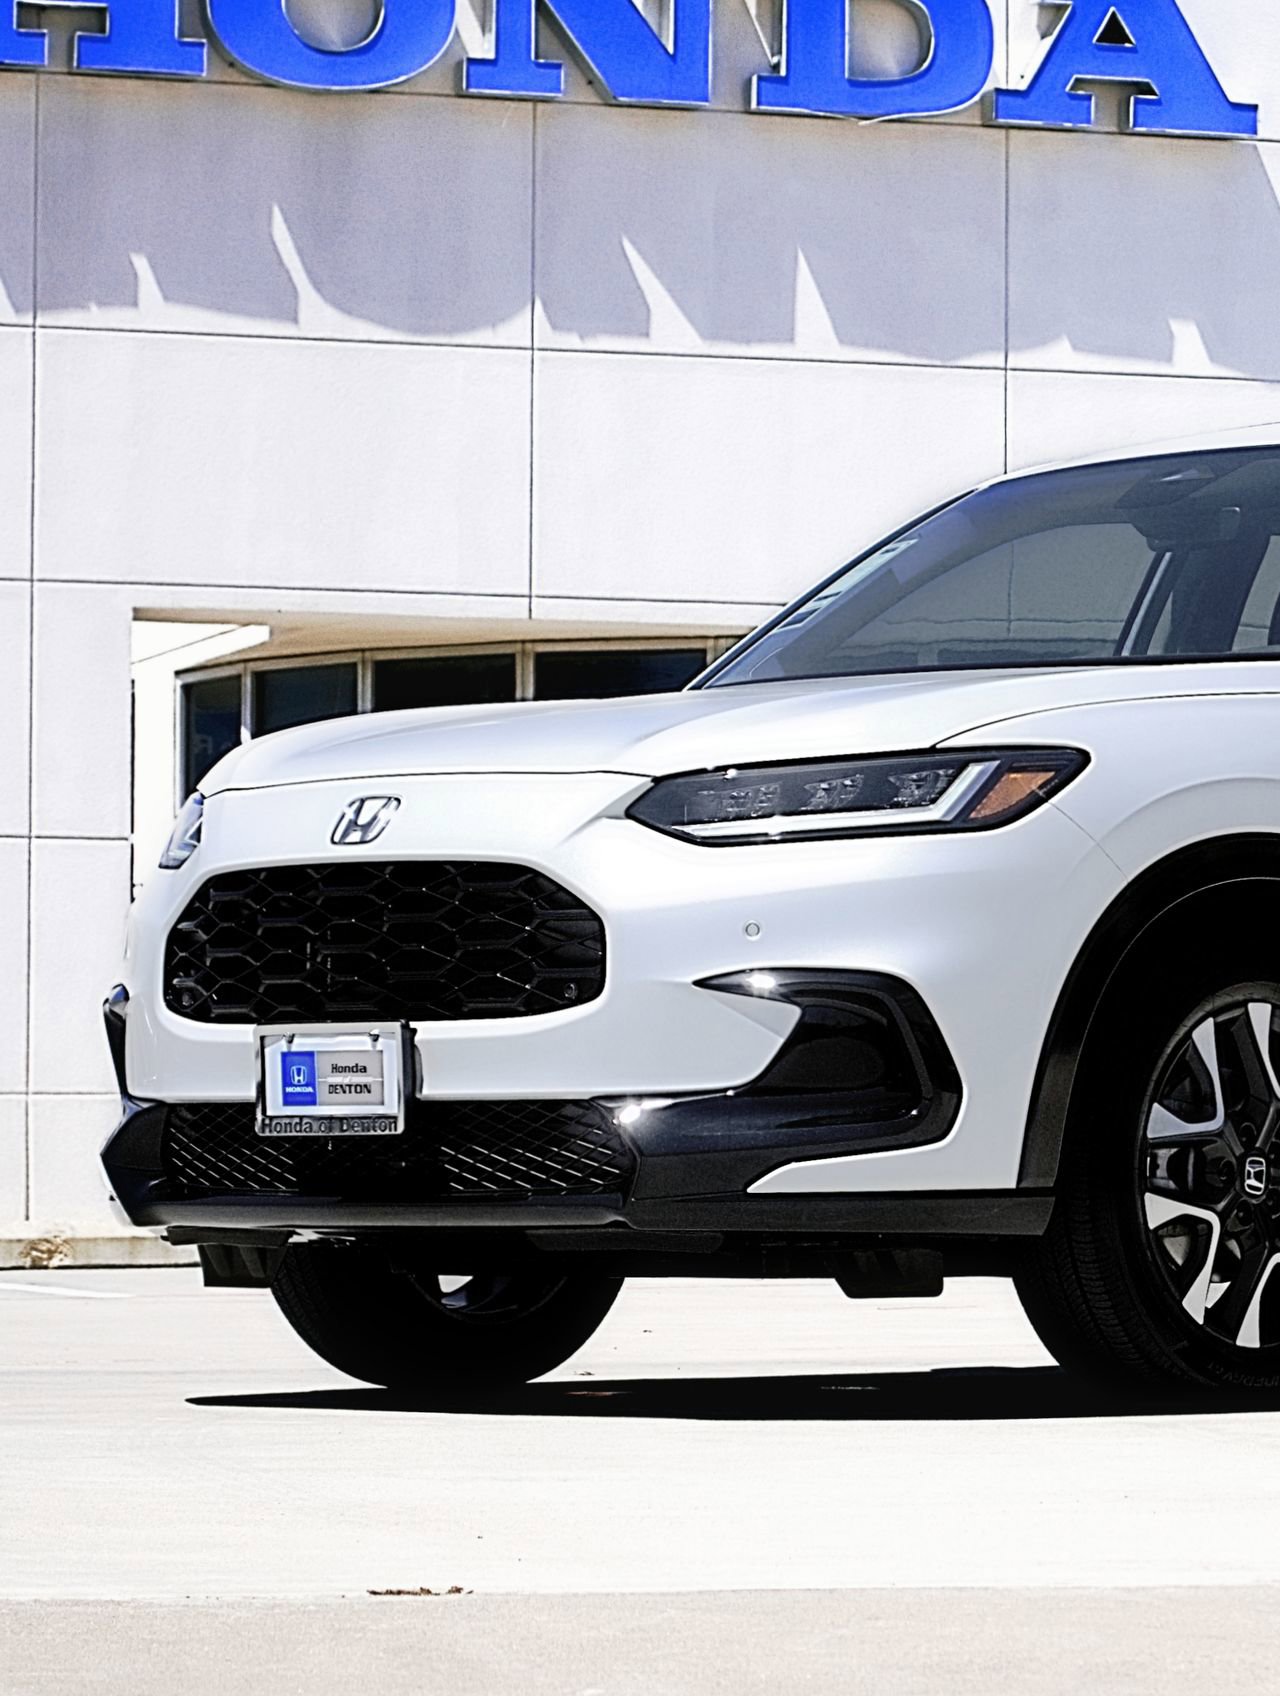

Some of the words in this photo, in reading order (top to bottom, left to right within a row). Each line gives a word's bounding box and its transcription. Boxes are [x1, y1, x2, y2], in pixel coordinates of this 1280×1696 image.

[331, 1063, 367, 1074] Honda
[328, 1083, 372, 1094] DENTON
[261, 1116, 313, 1134] Honda
[341, 1116, 398, 1134] Denton
